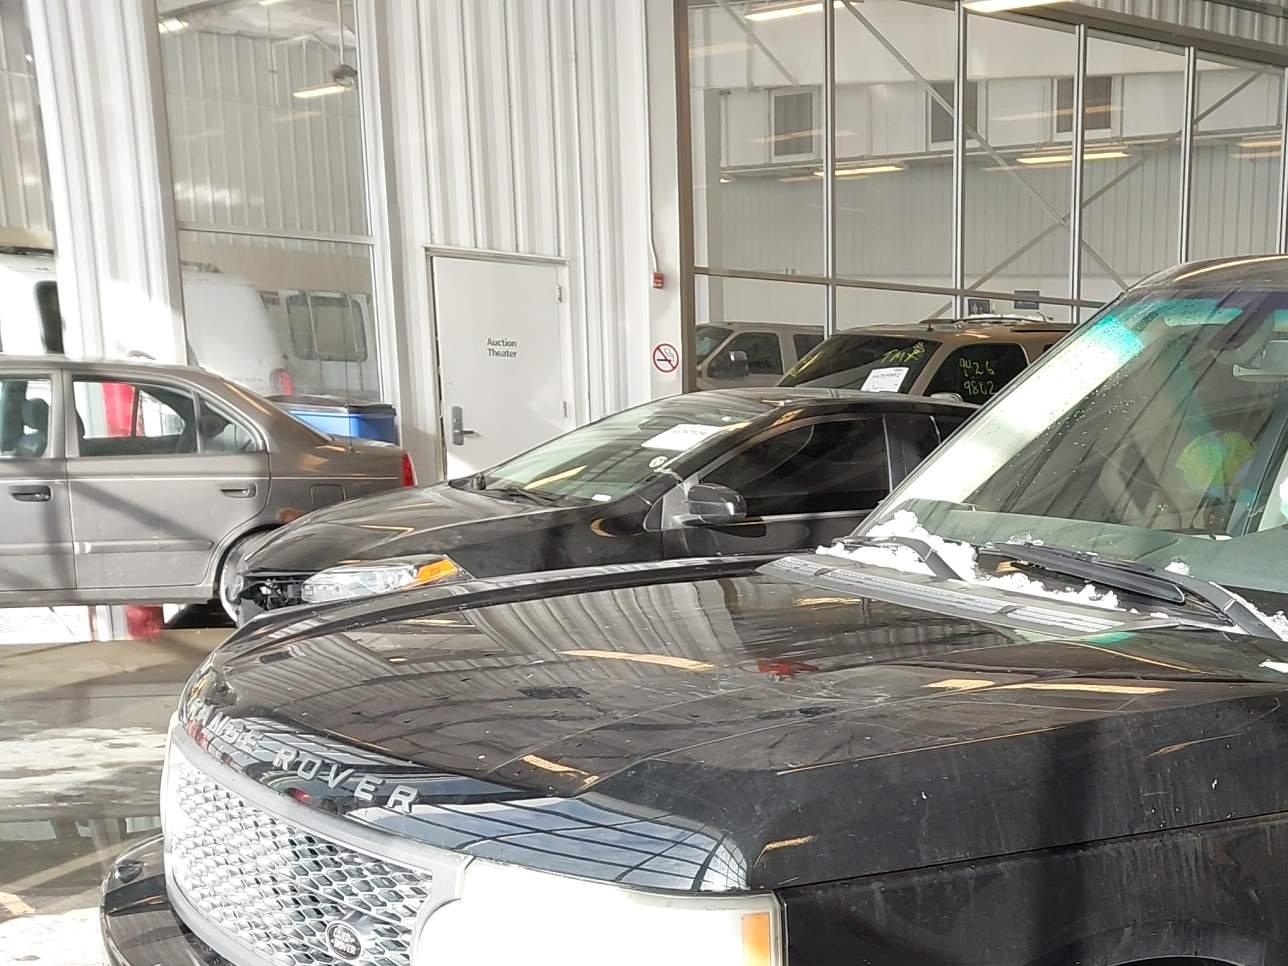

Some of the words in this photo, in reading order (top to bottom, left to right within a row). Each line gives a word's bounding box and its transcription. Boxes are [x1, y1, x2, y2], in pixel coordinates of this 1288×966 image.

[487, 337, 518, 347] Auction
[487, 348, 518, 358] Theater
[272, 747, 419, 813] ROVER
